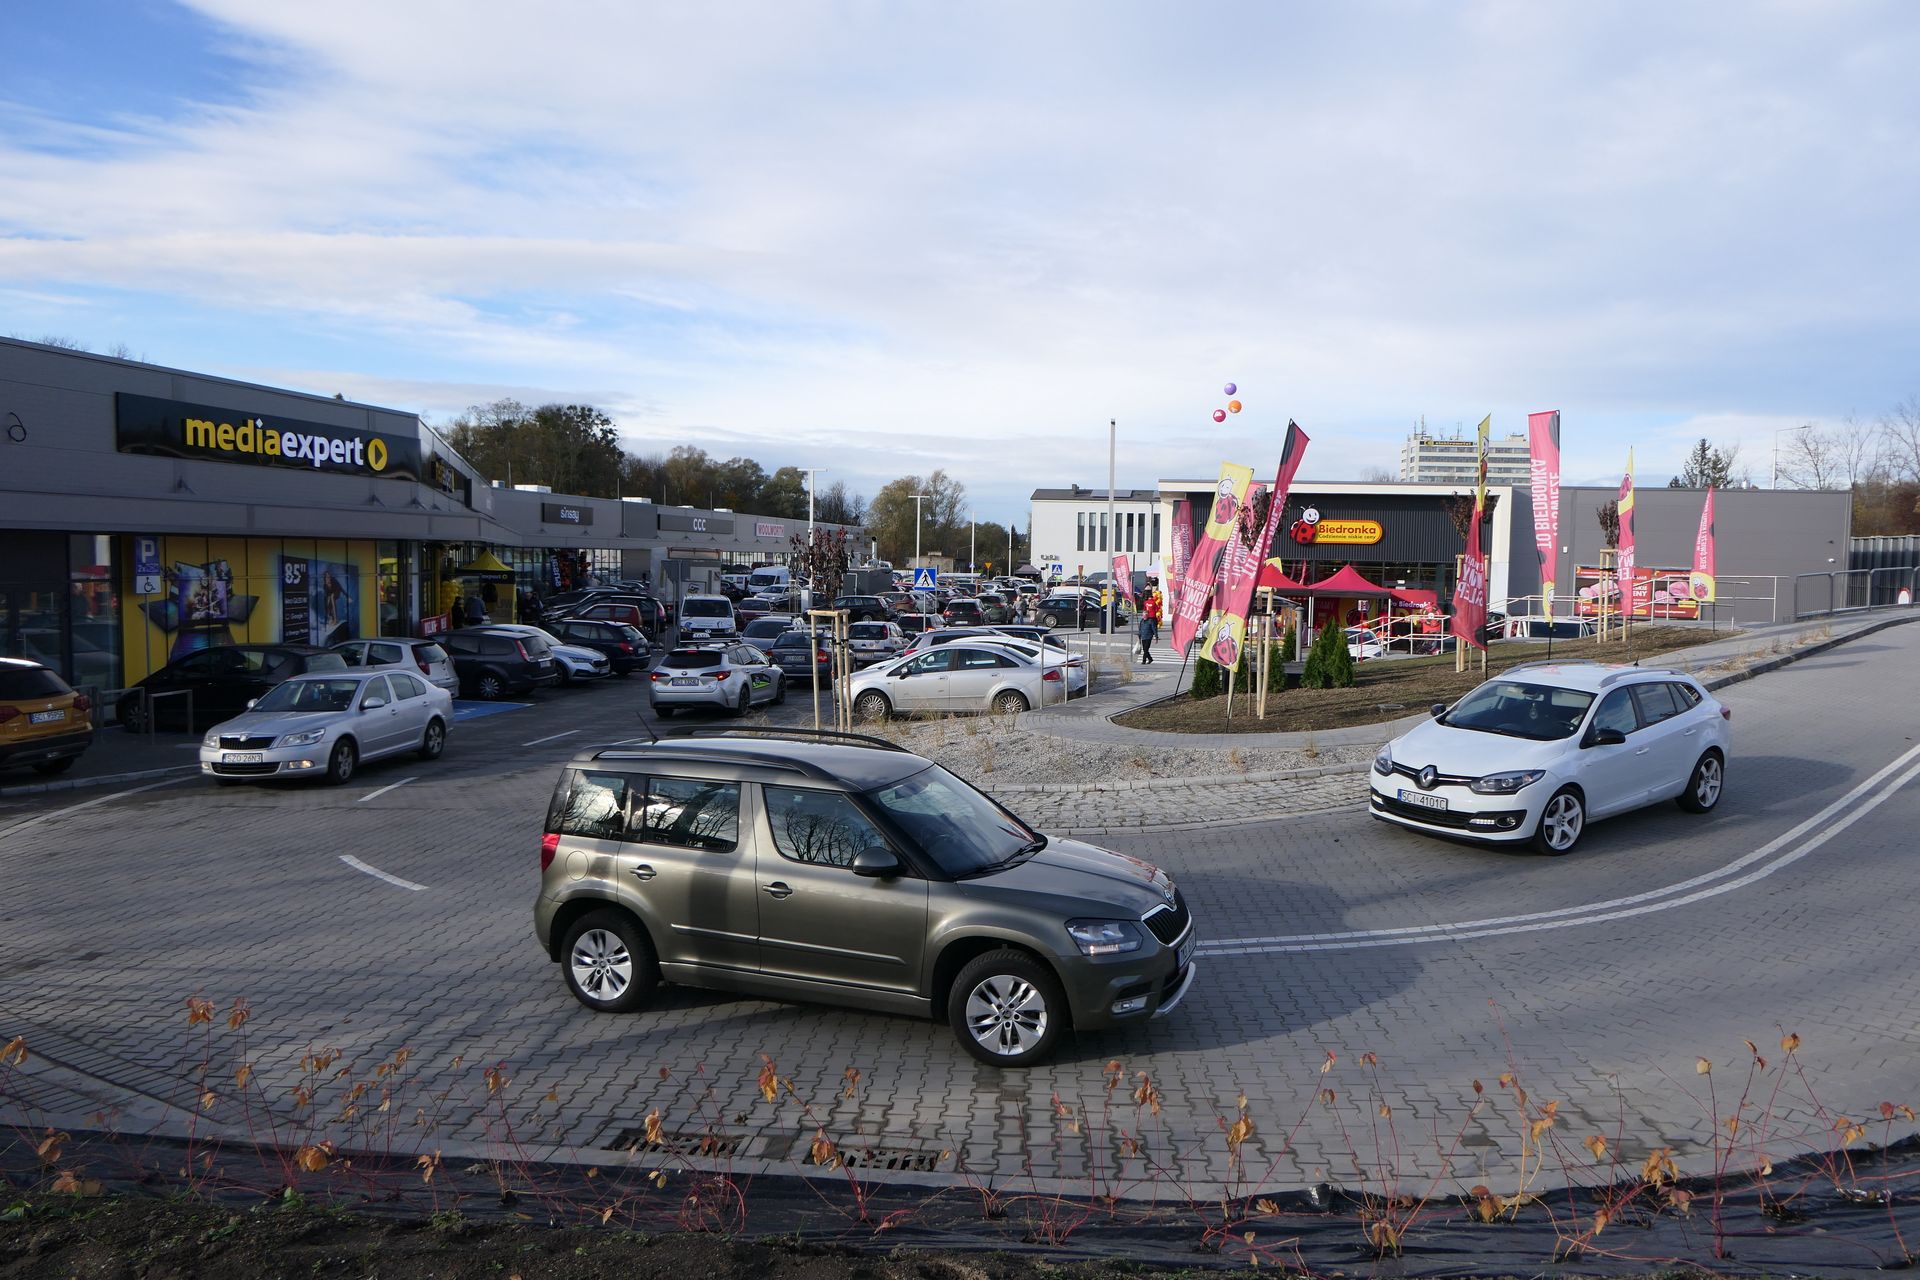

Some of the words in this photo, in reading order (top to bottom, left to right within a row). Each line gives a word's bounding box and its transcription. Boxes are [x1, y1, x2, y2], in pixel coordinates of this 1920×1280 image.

[186, 418, 364, 468] mediaexpert
[560, 507, 580, 523] sinsay
[693, 518, 706, 531] CCC
[1319, 525, 1376, 534] Biedronka
[141, 540, 155, 563] P
[1420, 795, 1446, 810] 4101C
